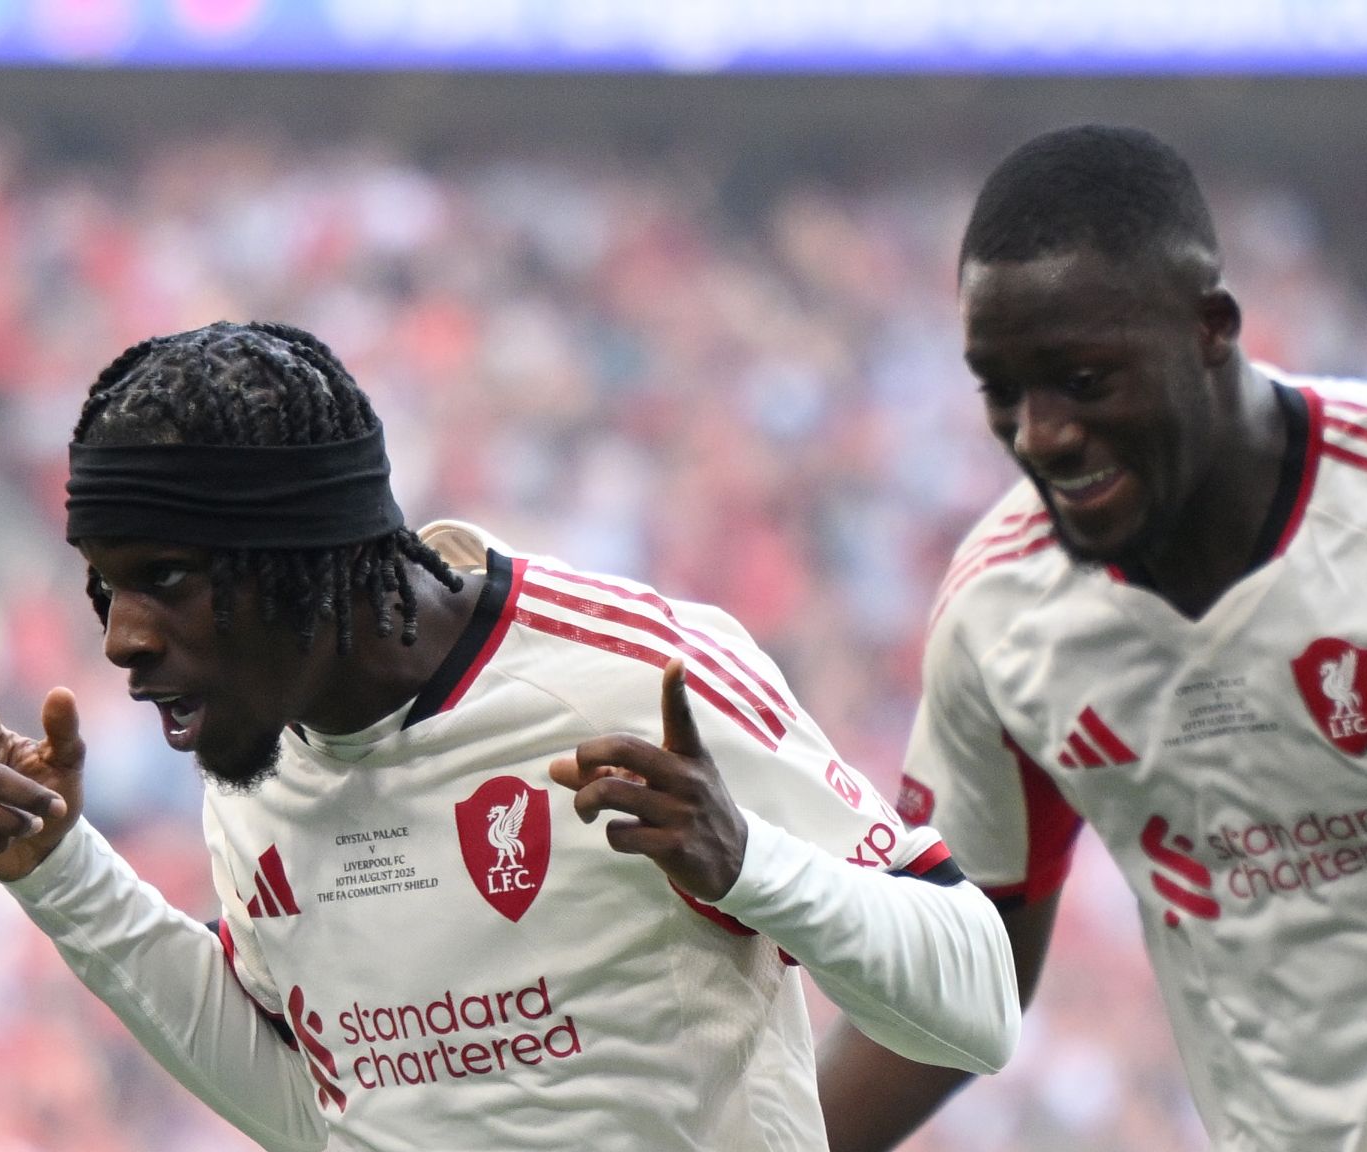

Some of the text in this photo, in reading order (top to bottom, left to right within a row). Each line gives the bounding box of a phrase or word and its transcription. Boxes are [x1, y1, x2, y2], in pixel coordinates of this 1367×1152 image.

[335, 827, 409, 846] CRYSTAL PALACE
[344, 854, 406, 872] LIVERPOOL FC
[335, 867, 416, 887] 10TH AUGUST 2025
[487, 869, 536, 894] L.F.C.
[317, 878, 439, 903] THE FA COMMUNITY SHIELD
[338, 976, 553, 1046] standard
[354, 1016, 582, 1090] chartered
